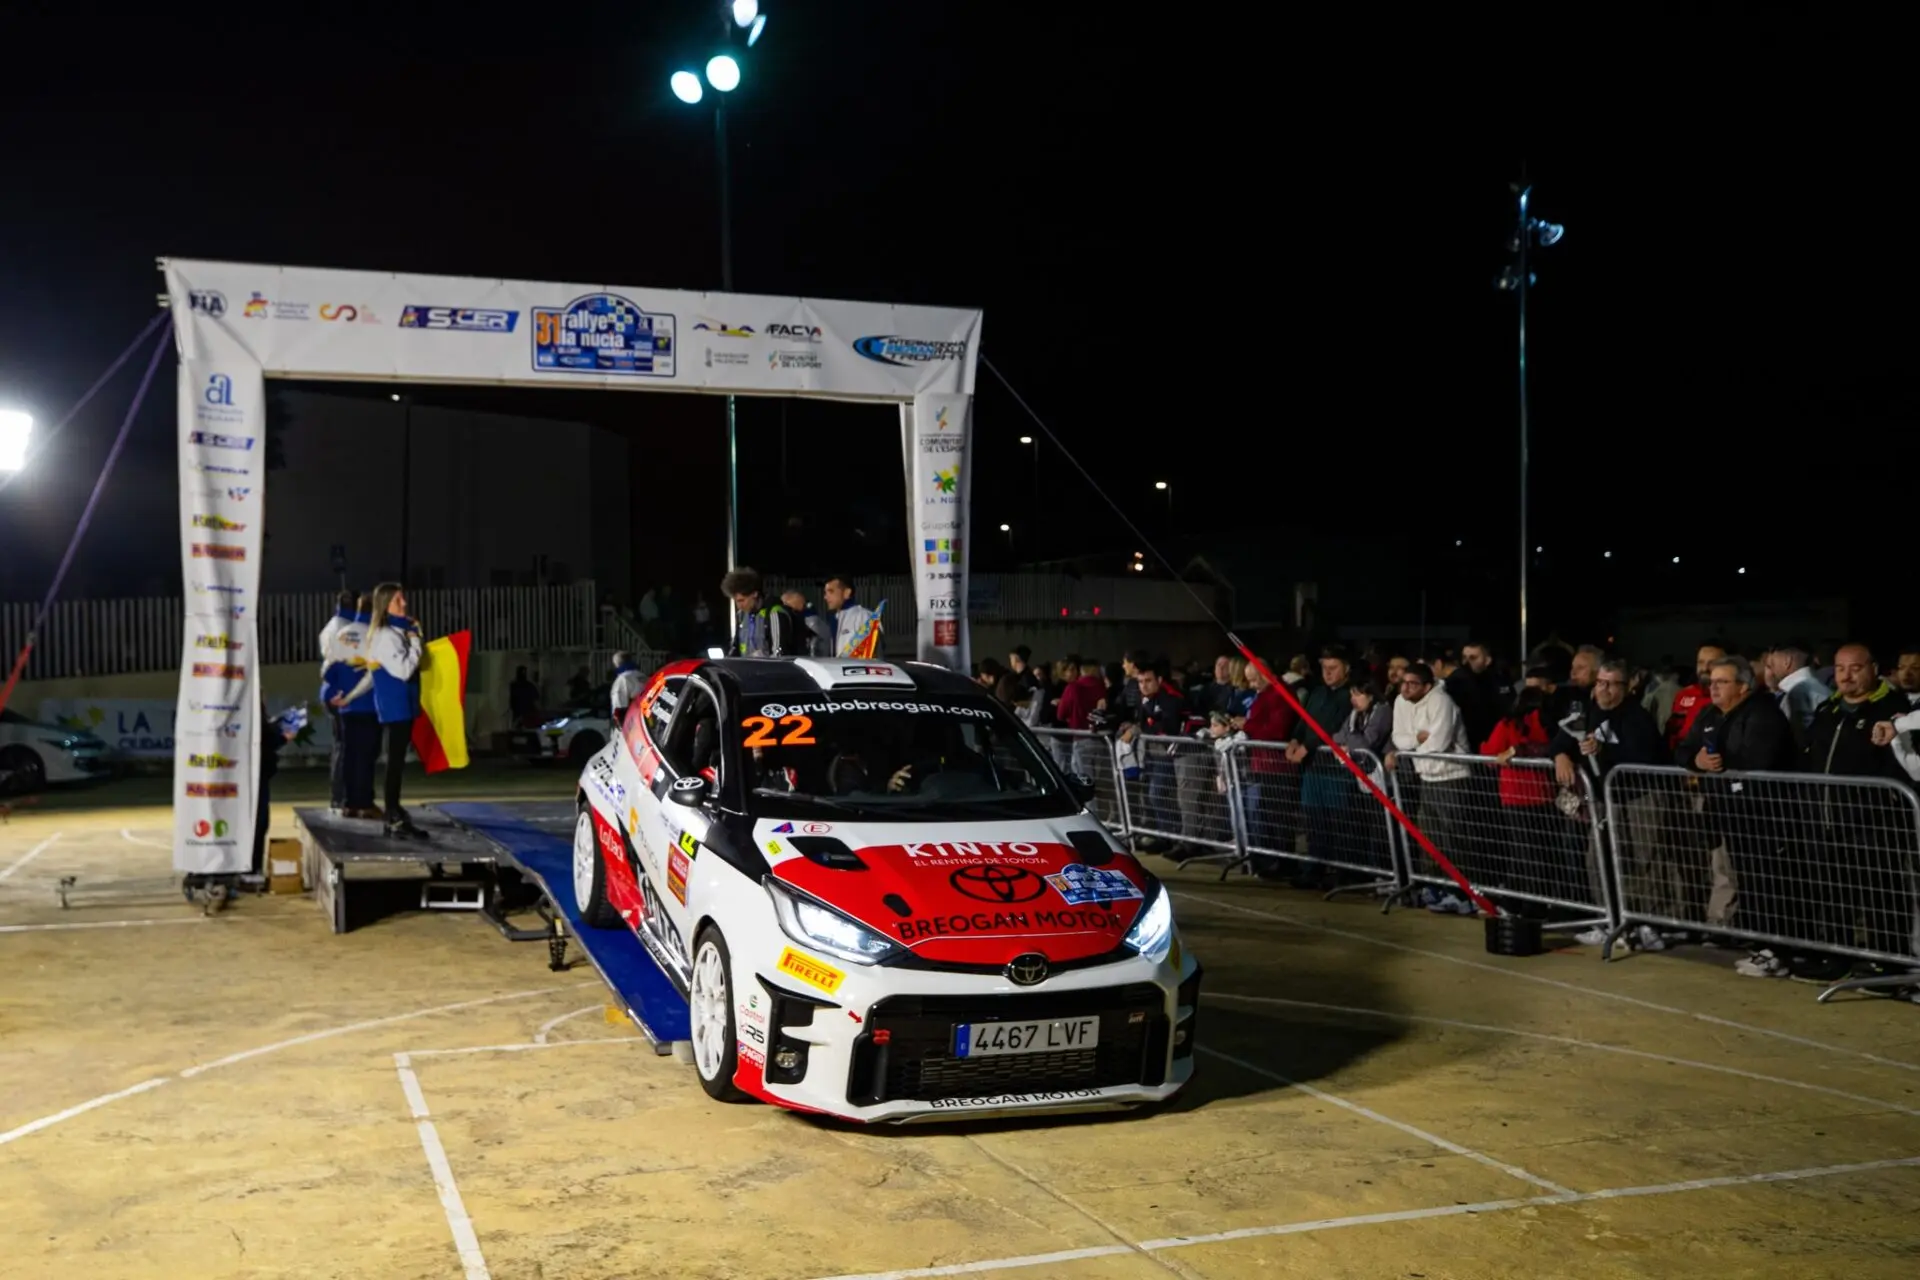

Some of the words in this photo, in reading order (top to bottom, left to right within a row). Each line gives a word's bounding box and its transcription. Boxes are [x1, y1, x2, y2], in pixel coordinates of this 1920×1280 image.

[189, 291, 224, 313] FIA
[536, 312, 560, 345] 31
[561, 310, 608, 332] rallye
[561, 328, 576, 345] la
[788, 699, 994, 720] grupobreogan.com
[117, 711, 150, 734] LA
[741, 715, 816, 748] 22
[914, 859, 929, 867] EL
[930, 858, 984, 866] RENTING
[984, 857, 1001, 865] DE
[1001, 857, 1049, 865] TOYOTA
[900, 911, 1029, 940] BREOGAN
[1036, 911, 1123, 930] MOTOR
[783, 953, 838, 989] PIRELLI
[975, 1025, 1039, 1050] 4467
[1048, 1021, 1093, 1047] LVF
[930, 1093, 1030, 1109] BREOGAN
[1034, 1088, 1102, 1101] MOTOR
